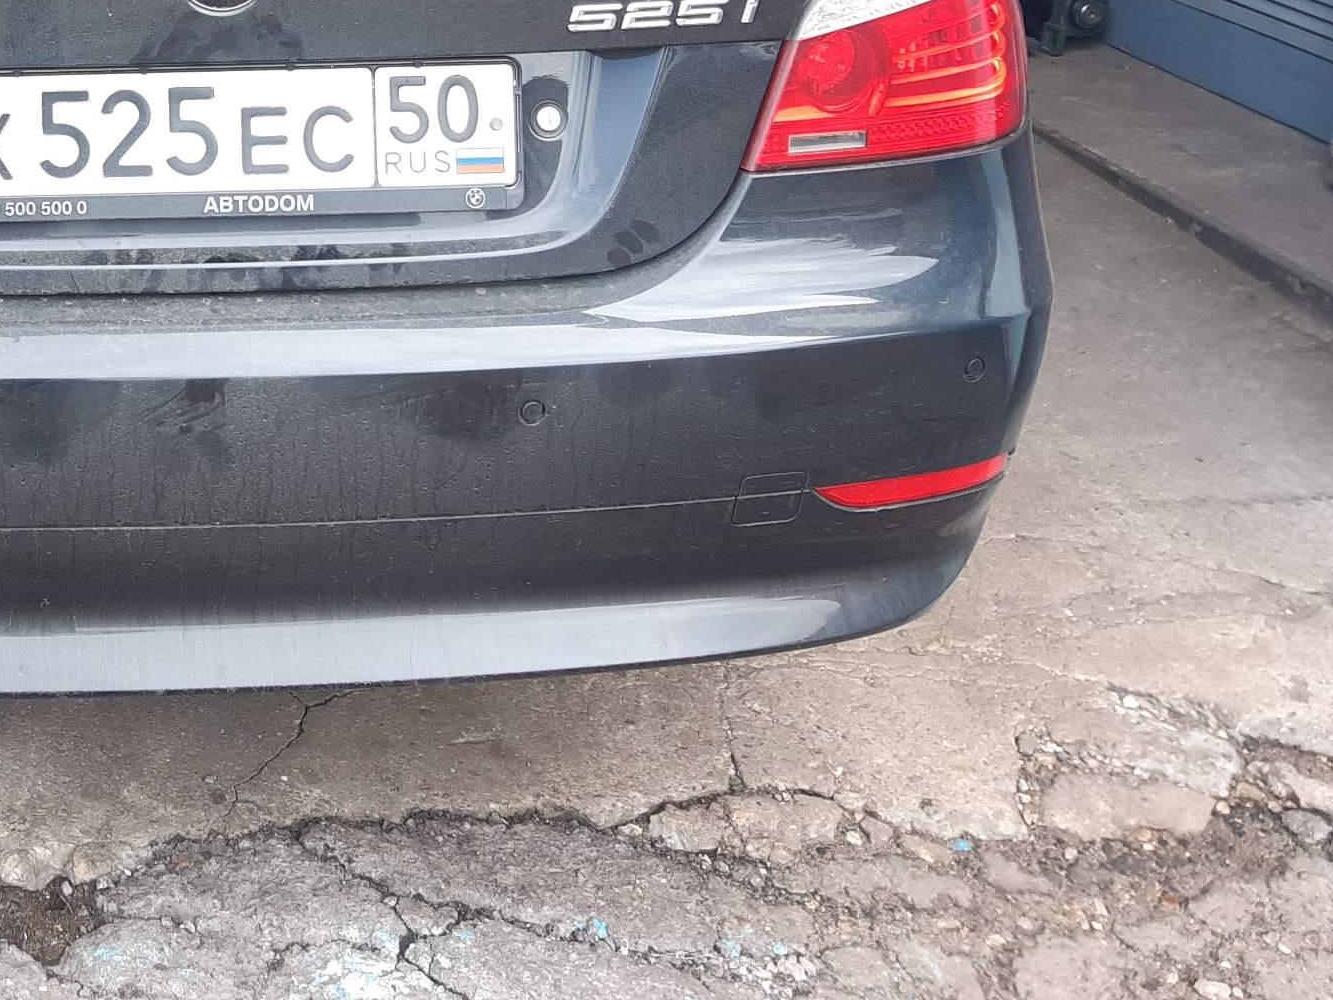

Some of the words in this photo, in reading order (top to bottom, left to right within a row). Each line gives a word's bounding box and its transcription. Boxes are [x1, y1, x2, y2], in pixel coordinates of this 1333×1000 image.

[389, 75, 479, 144] 50
[384, 150, 451, 175] RUS
[5, 201, 37, 217] 500
[41, 201, 73, 216] 500
[76, 201, 88, 215] 0
